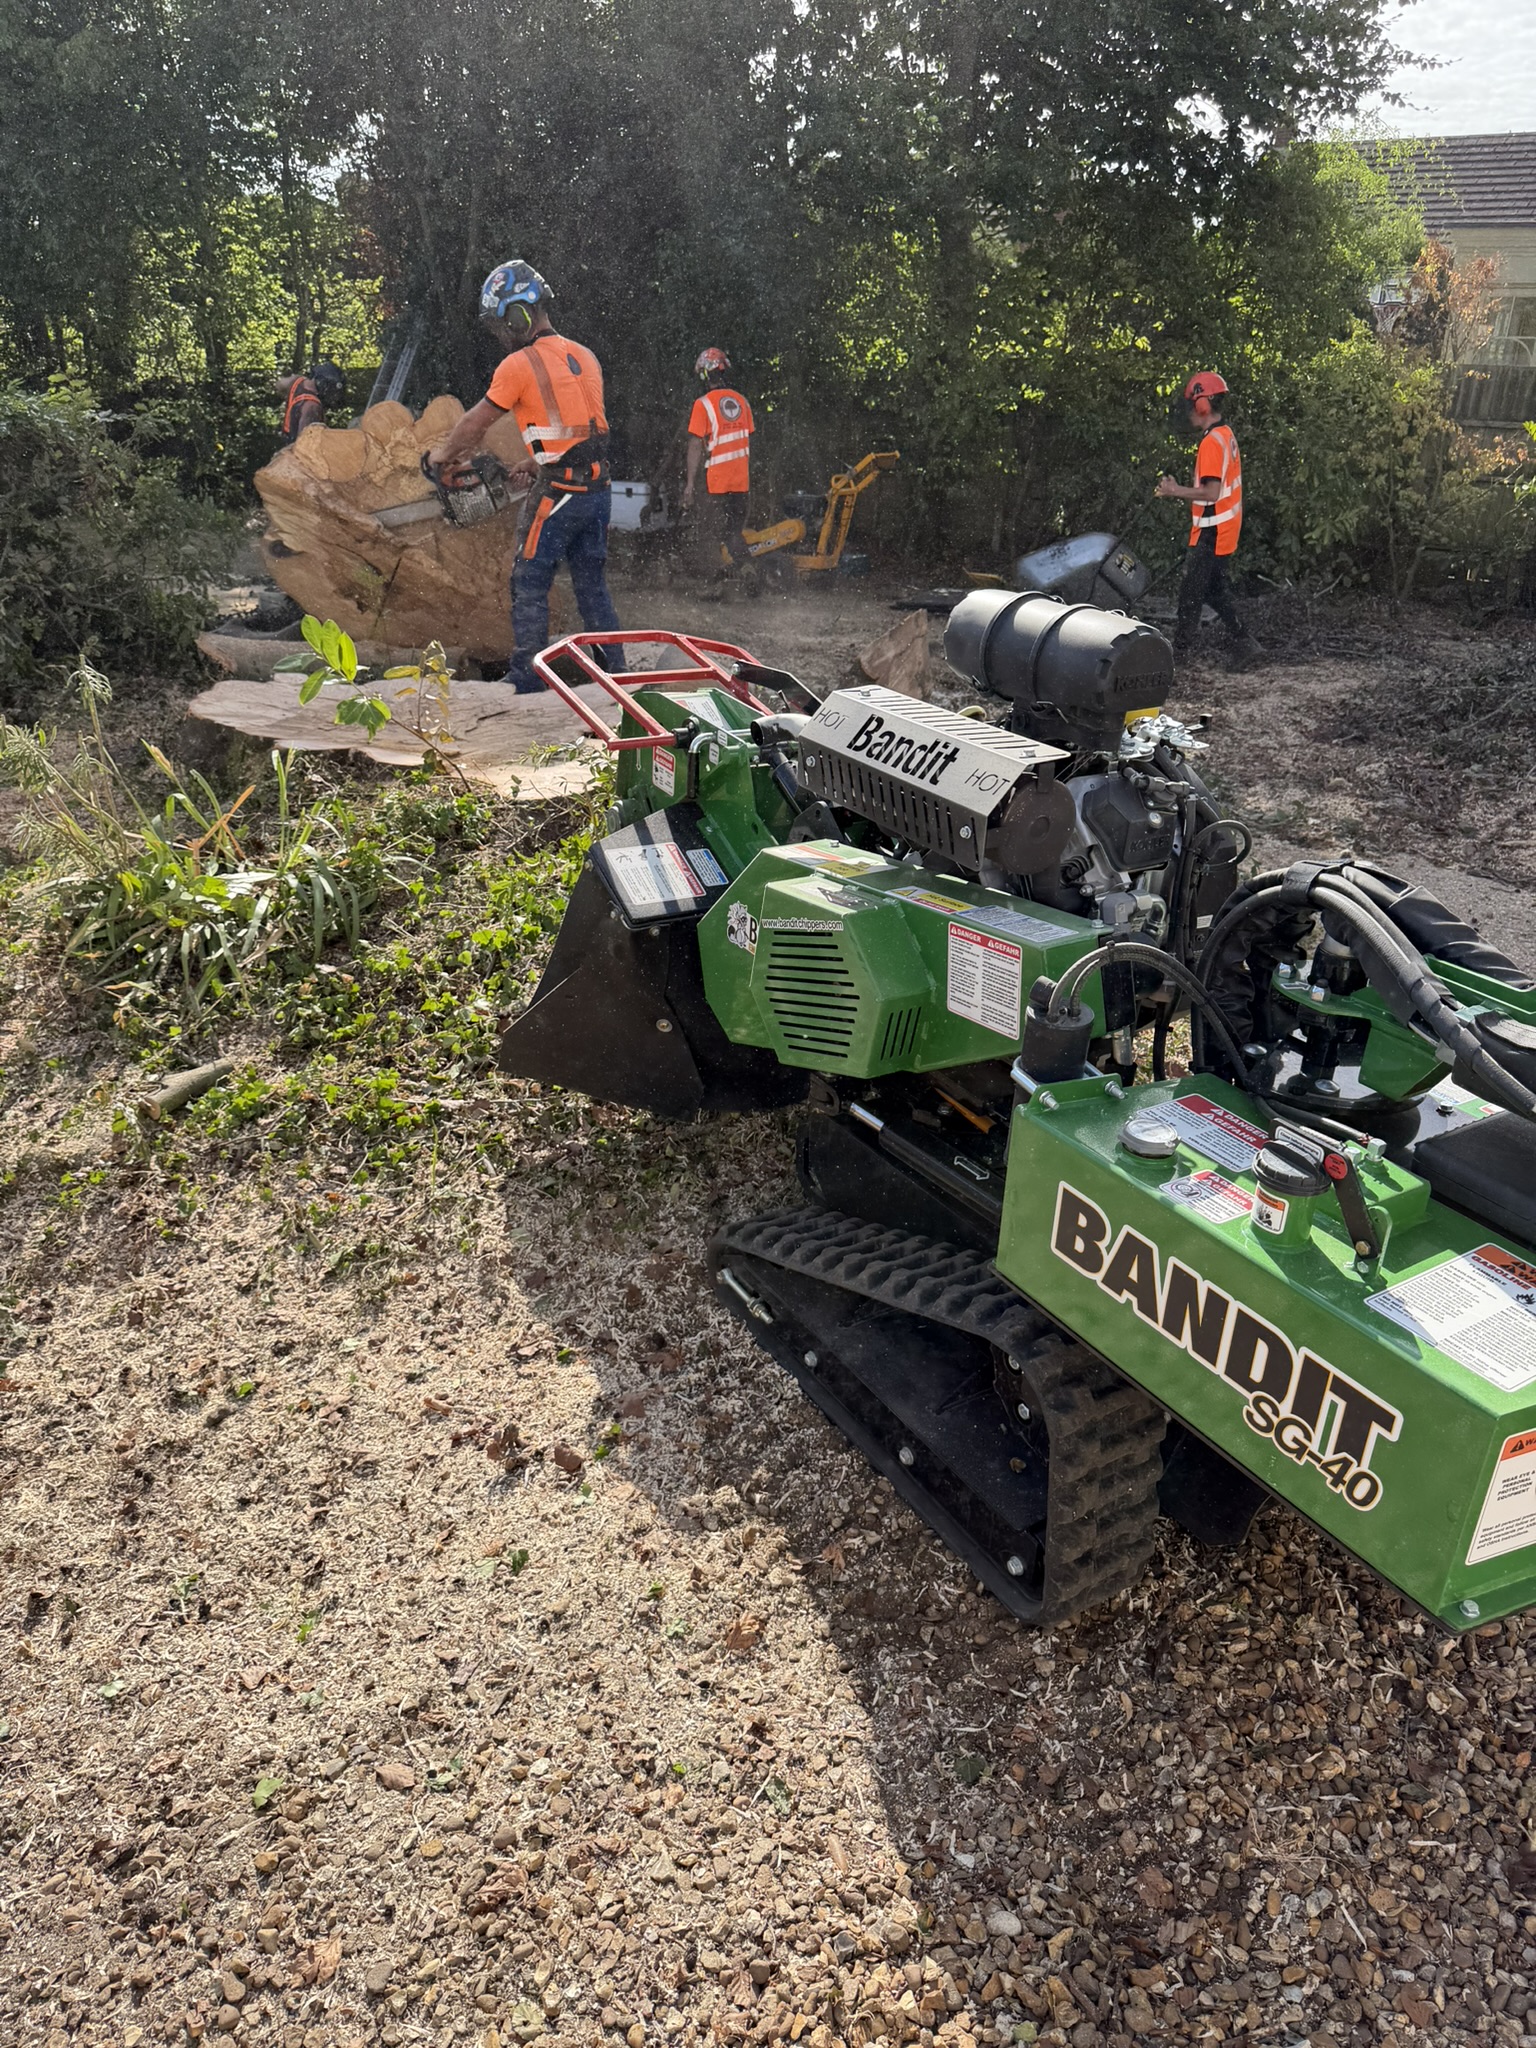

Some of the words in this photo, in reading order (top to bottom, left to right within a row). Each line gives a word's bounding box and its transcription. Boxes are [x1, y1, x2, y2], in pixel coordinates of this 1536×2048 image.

[813, 708, 849, 730] HOT
[846, 713, 961, 786] Bandit
[964, 768, 1010, 795] HOT
[762, 916, 843, 931] www.banditchippers.com
[957, 928, 981, 943] DANGER
[994, 942, 1020, 957] GEFAHR
[1214, 1117, 1257, 1143] GEFAHR
[1224, 1113, 1270, 1140] DANGER
[1211, 1182, 1248, 1206] GEFAHR
[1471, 1255, 1532, 1291] GASOLINE
[1052, 1182, 1402, 1469] BANDIT
[1242, 1391, 1383, 1511] SG-40
[1497, 1482, 1533, 1495] PROTECTION
[1502, 1475, 1518, 1484] WEAR
[1519, 1471, 1530, 1479] EYE
[1502, 1477, 1531, 1489] PERSONAL
[1497, 1488, 1530, 1501] EQUIPMENT
